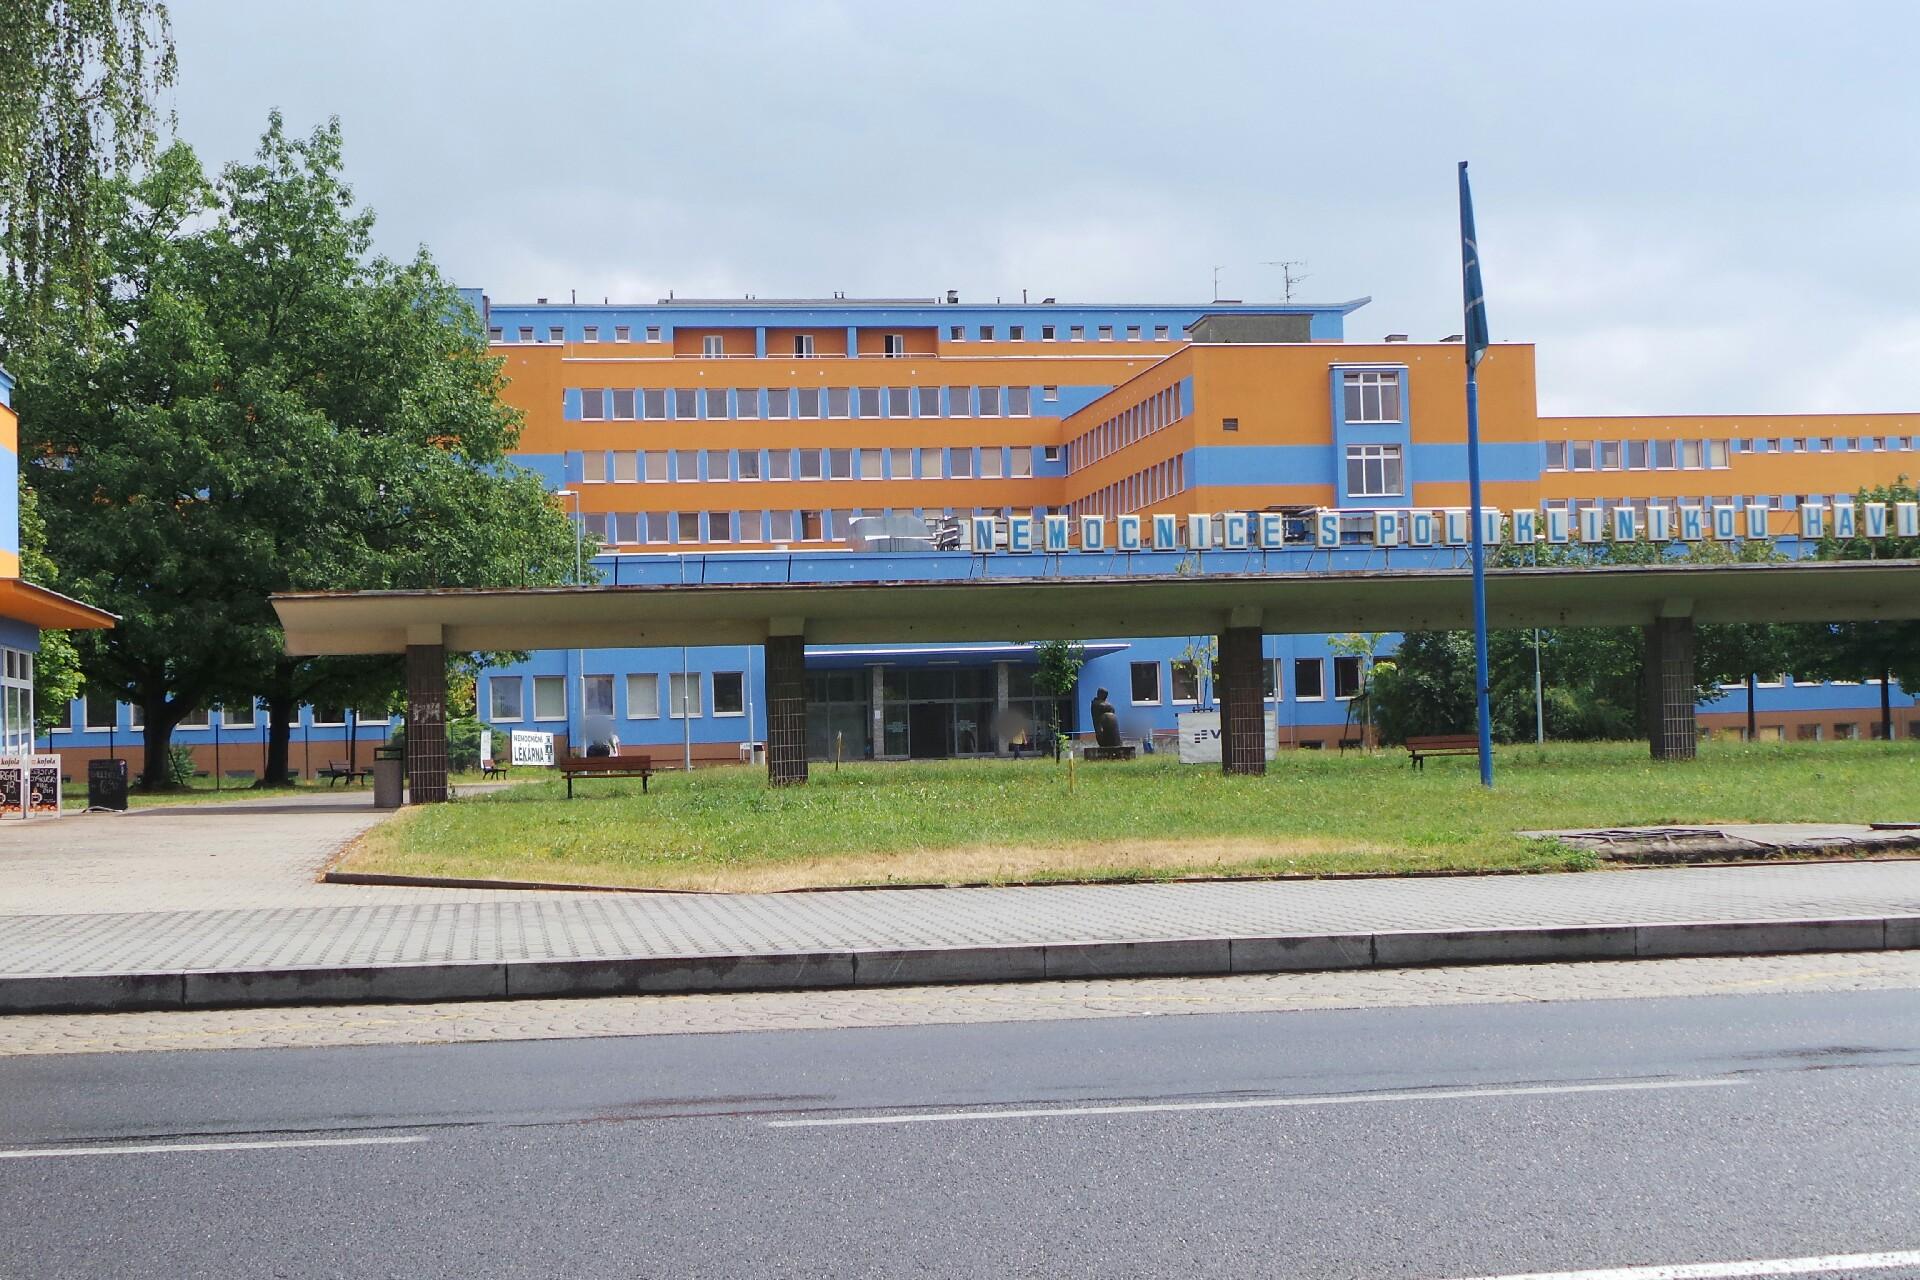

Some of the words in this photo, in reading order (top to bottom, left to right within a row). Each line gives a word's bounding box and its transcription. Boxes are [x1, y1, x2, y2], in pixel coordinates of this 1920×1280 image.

[975, 515, 1281, 551] NEMOCNICE
[1320, 513, 1340, 547] S
[1378, 508, 1767, 546] POLIKLINIKOU
[514, 743, 545, 762] LÉKÁRNA
